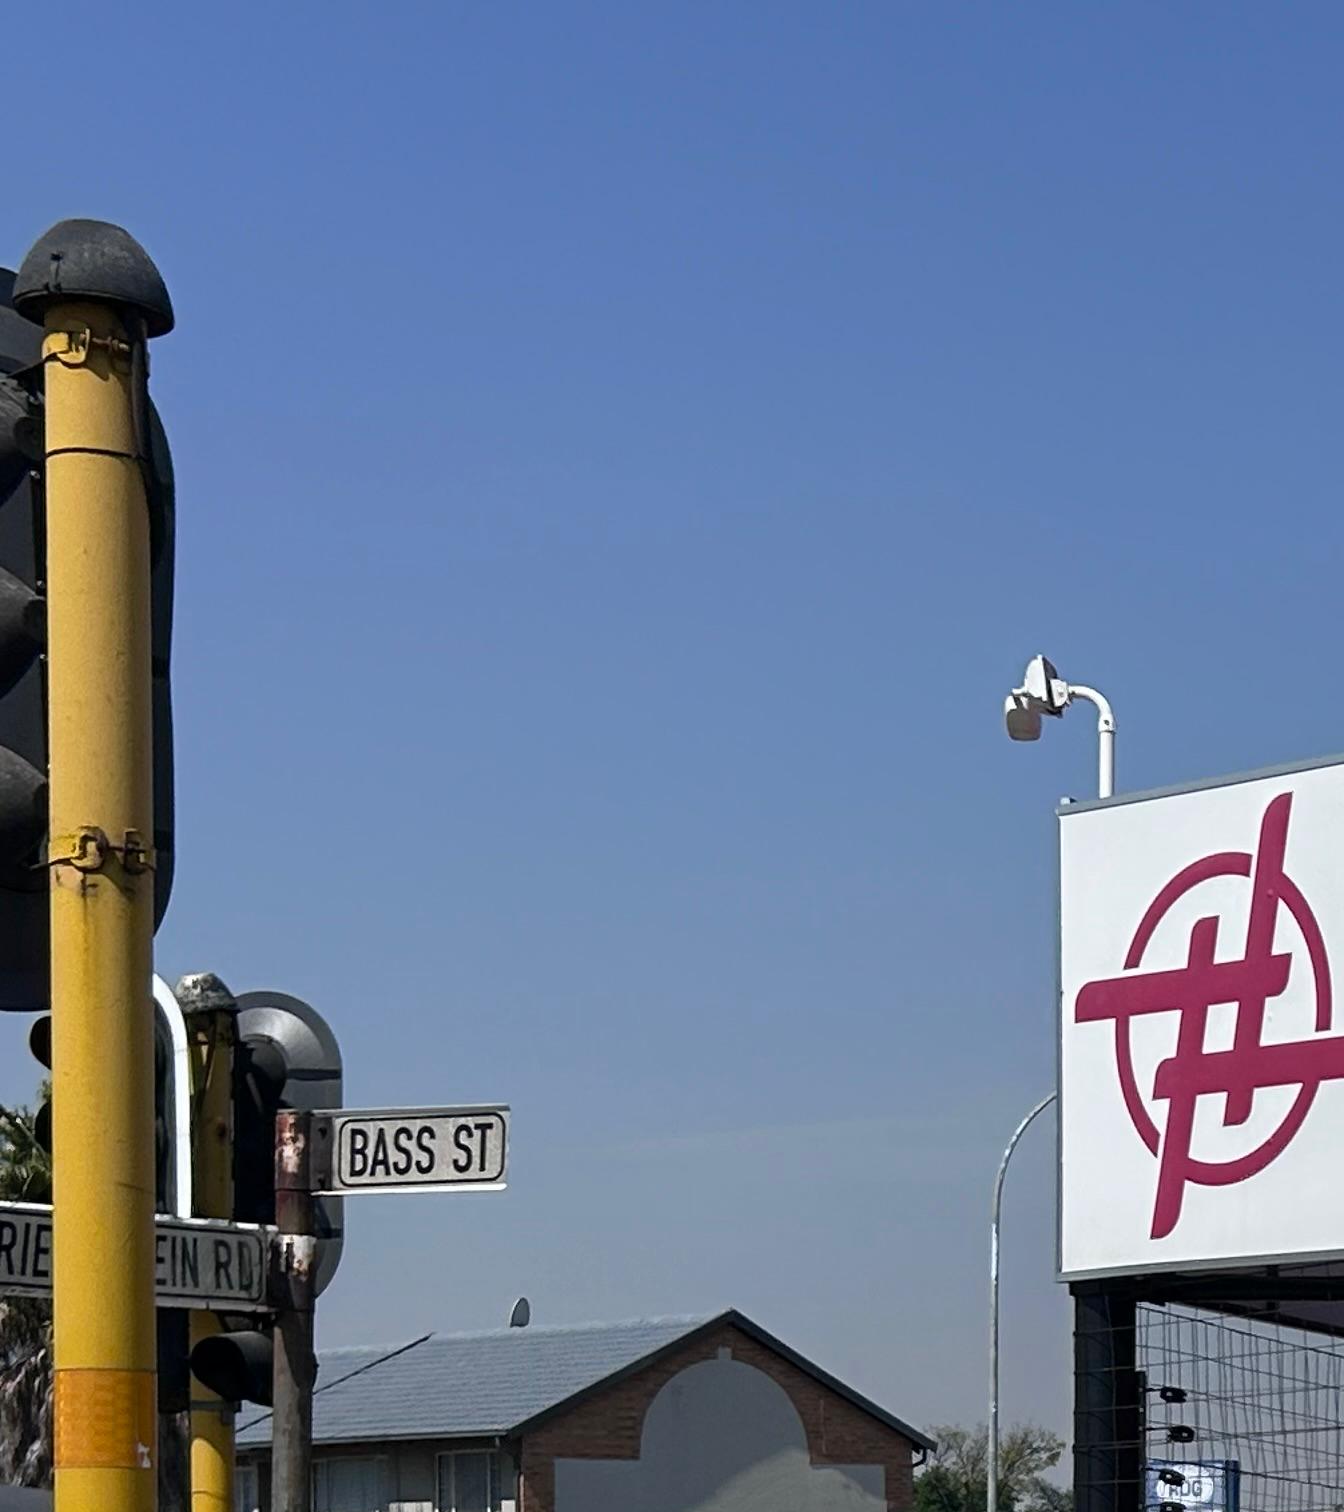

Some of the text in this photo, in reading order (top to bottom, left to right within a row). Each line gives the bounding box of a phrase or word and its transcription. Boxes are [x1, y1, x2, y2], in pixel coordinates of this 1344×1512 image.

[349, 1122, 494, 1178] BASS ST
[213, 1238, 260, 1293] RD
